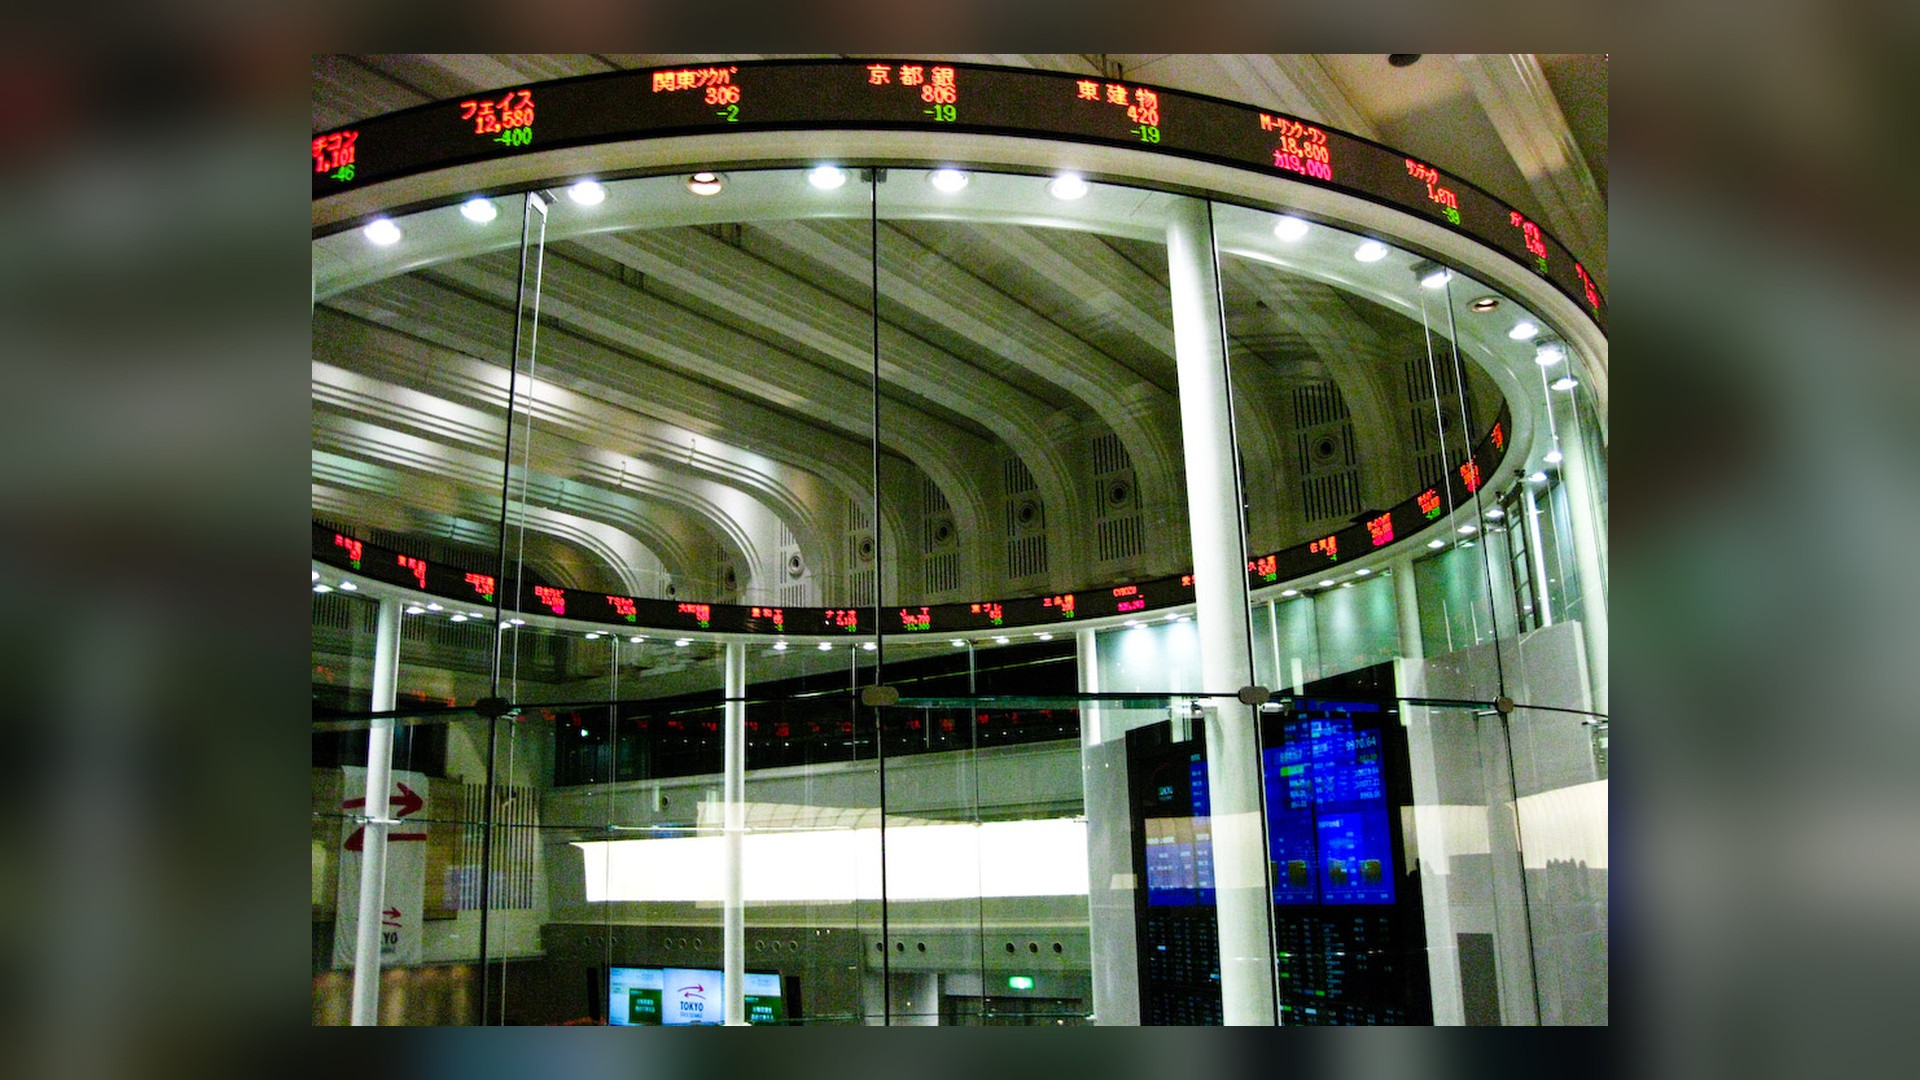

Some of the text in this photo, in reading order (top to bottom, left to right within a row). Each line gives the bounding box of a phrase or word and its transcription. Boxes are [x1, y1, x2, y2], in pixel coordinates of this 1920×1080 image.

[867, 65, 955, 88] 京都銀
[704, 86, 740, 105] 306
[921, 86, 956, 104] 806
[1076, 80, 1159, 109] 東建物
[460, 89, 535, 121] フェイス
[715, 104, 740, 122] -2
[924, 104, 957, 122] -19
[475, 109, 535, 135] 12,580
[1127, 105, 1160, 127] 420
[493, 127, 533, 147] -400
[1130, 126, 1161, 144] -19
[315, 145, 356, 173] 1,101
[1280, 136, 1329, 165] 18,800
[330, 164, 356, 183] -46
[680, 1001, 704, 1012] TOKYO
